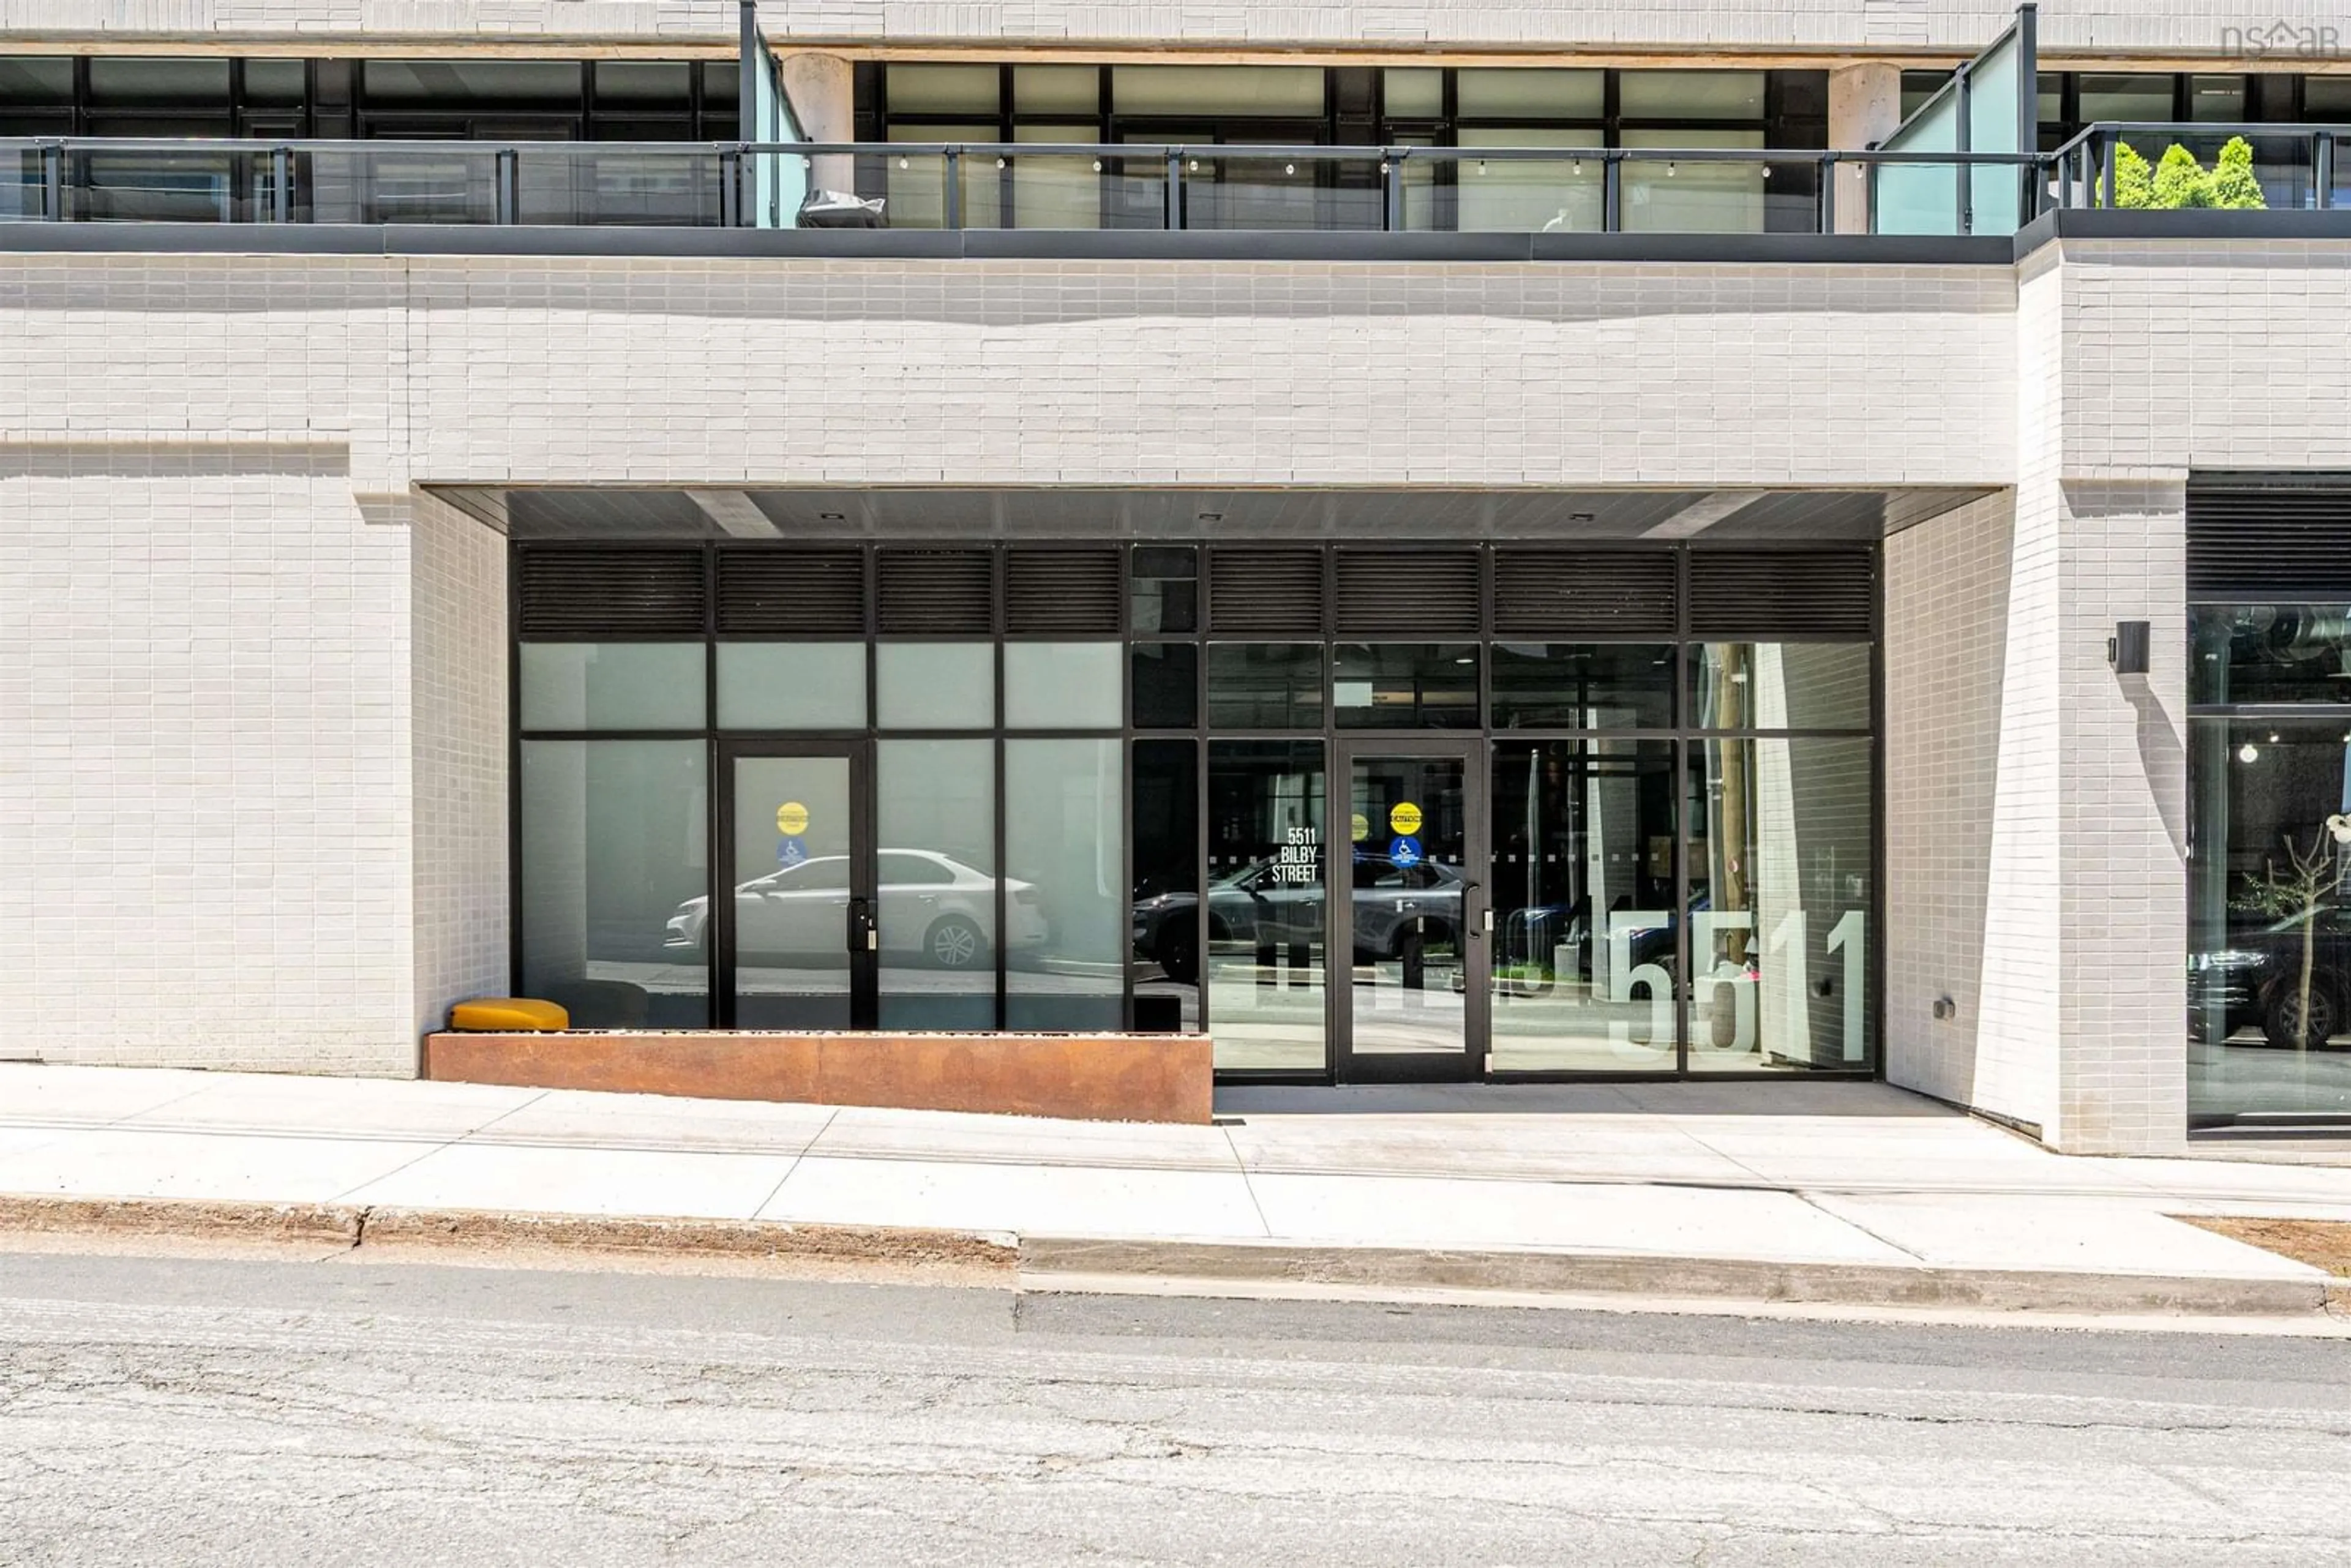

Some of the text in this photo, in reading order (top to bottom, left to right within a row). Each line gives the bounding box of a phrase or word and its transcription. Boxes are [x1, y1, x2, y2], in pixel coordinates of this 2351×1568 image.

[1288, 827, 1316, 844] 5511
[1281, 846, 1317, 863] BILBY
[1272, 865, 1318, 882] STREET
[1608, 910, 1864, 1062] 5511
